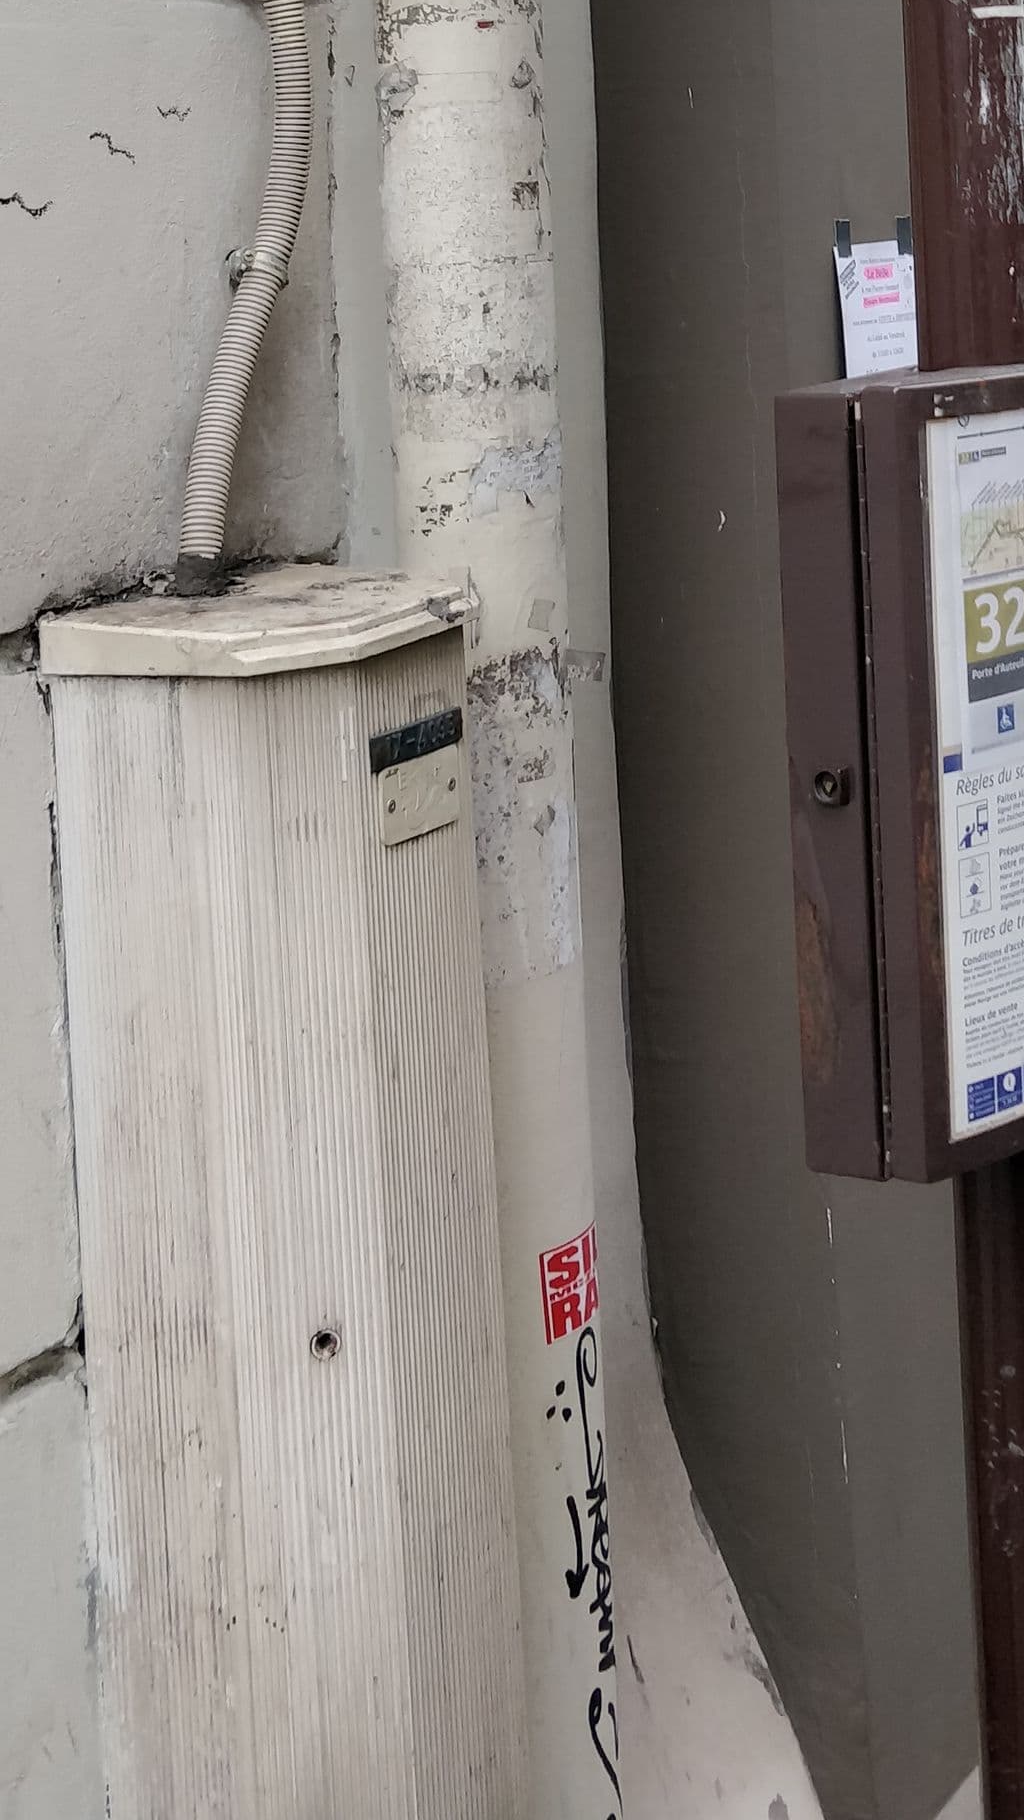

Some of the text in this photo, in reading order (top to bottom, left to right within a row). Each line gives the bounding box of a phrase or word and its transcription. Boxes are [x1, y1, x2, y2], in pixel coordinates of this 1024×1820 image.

[972, 657, 1024, 680] Porte d'Auteuil
[956, 774, 994, 796] Règles
[998, 767, 1012, 785] du
[999, 857, 1017, 870] votre
[962, 924, 996, 947] Titres
[999, 918, 1013, 936] de
[962, 944, 1002, 967] Conditions
[964, 1002, 1018, 1027] Lieux de vente
[547, 1226, 598, 1289] SI
